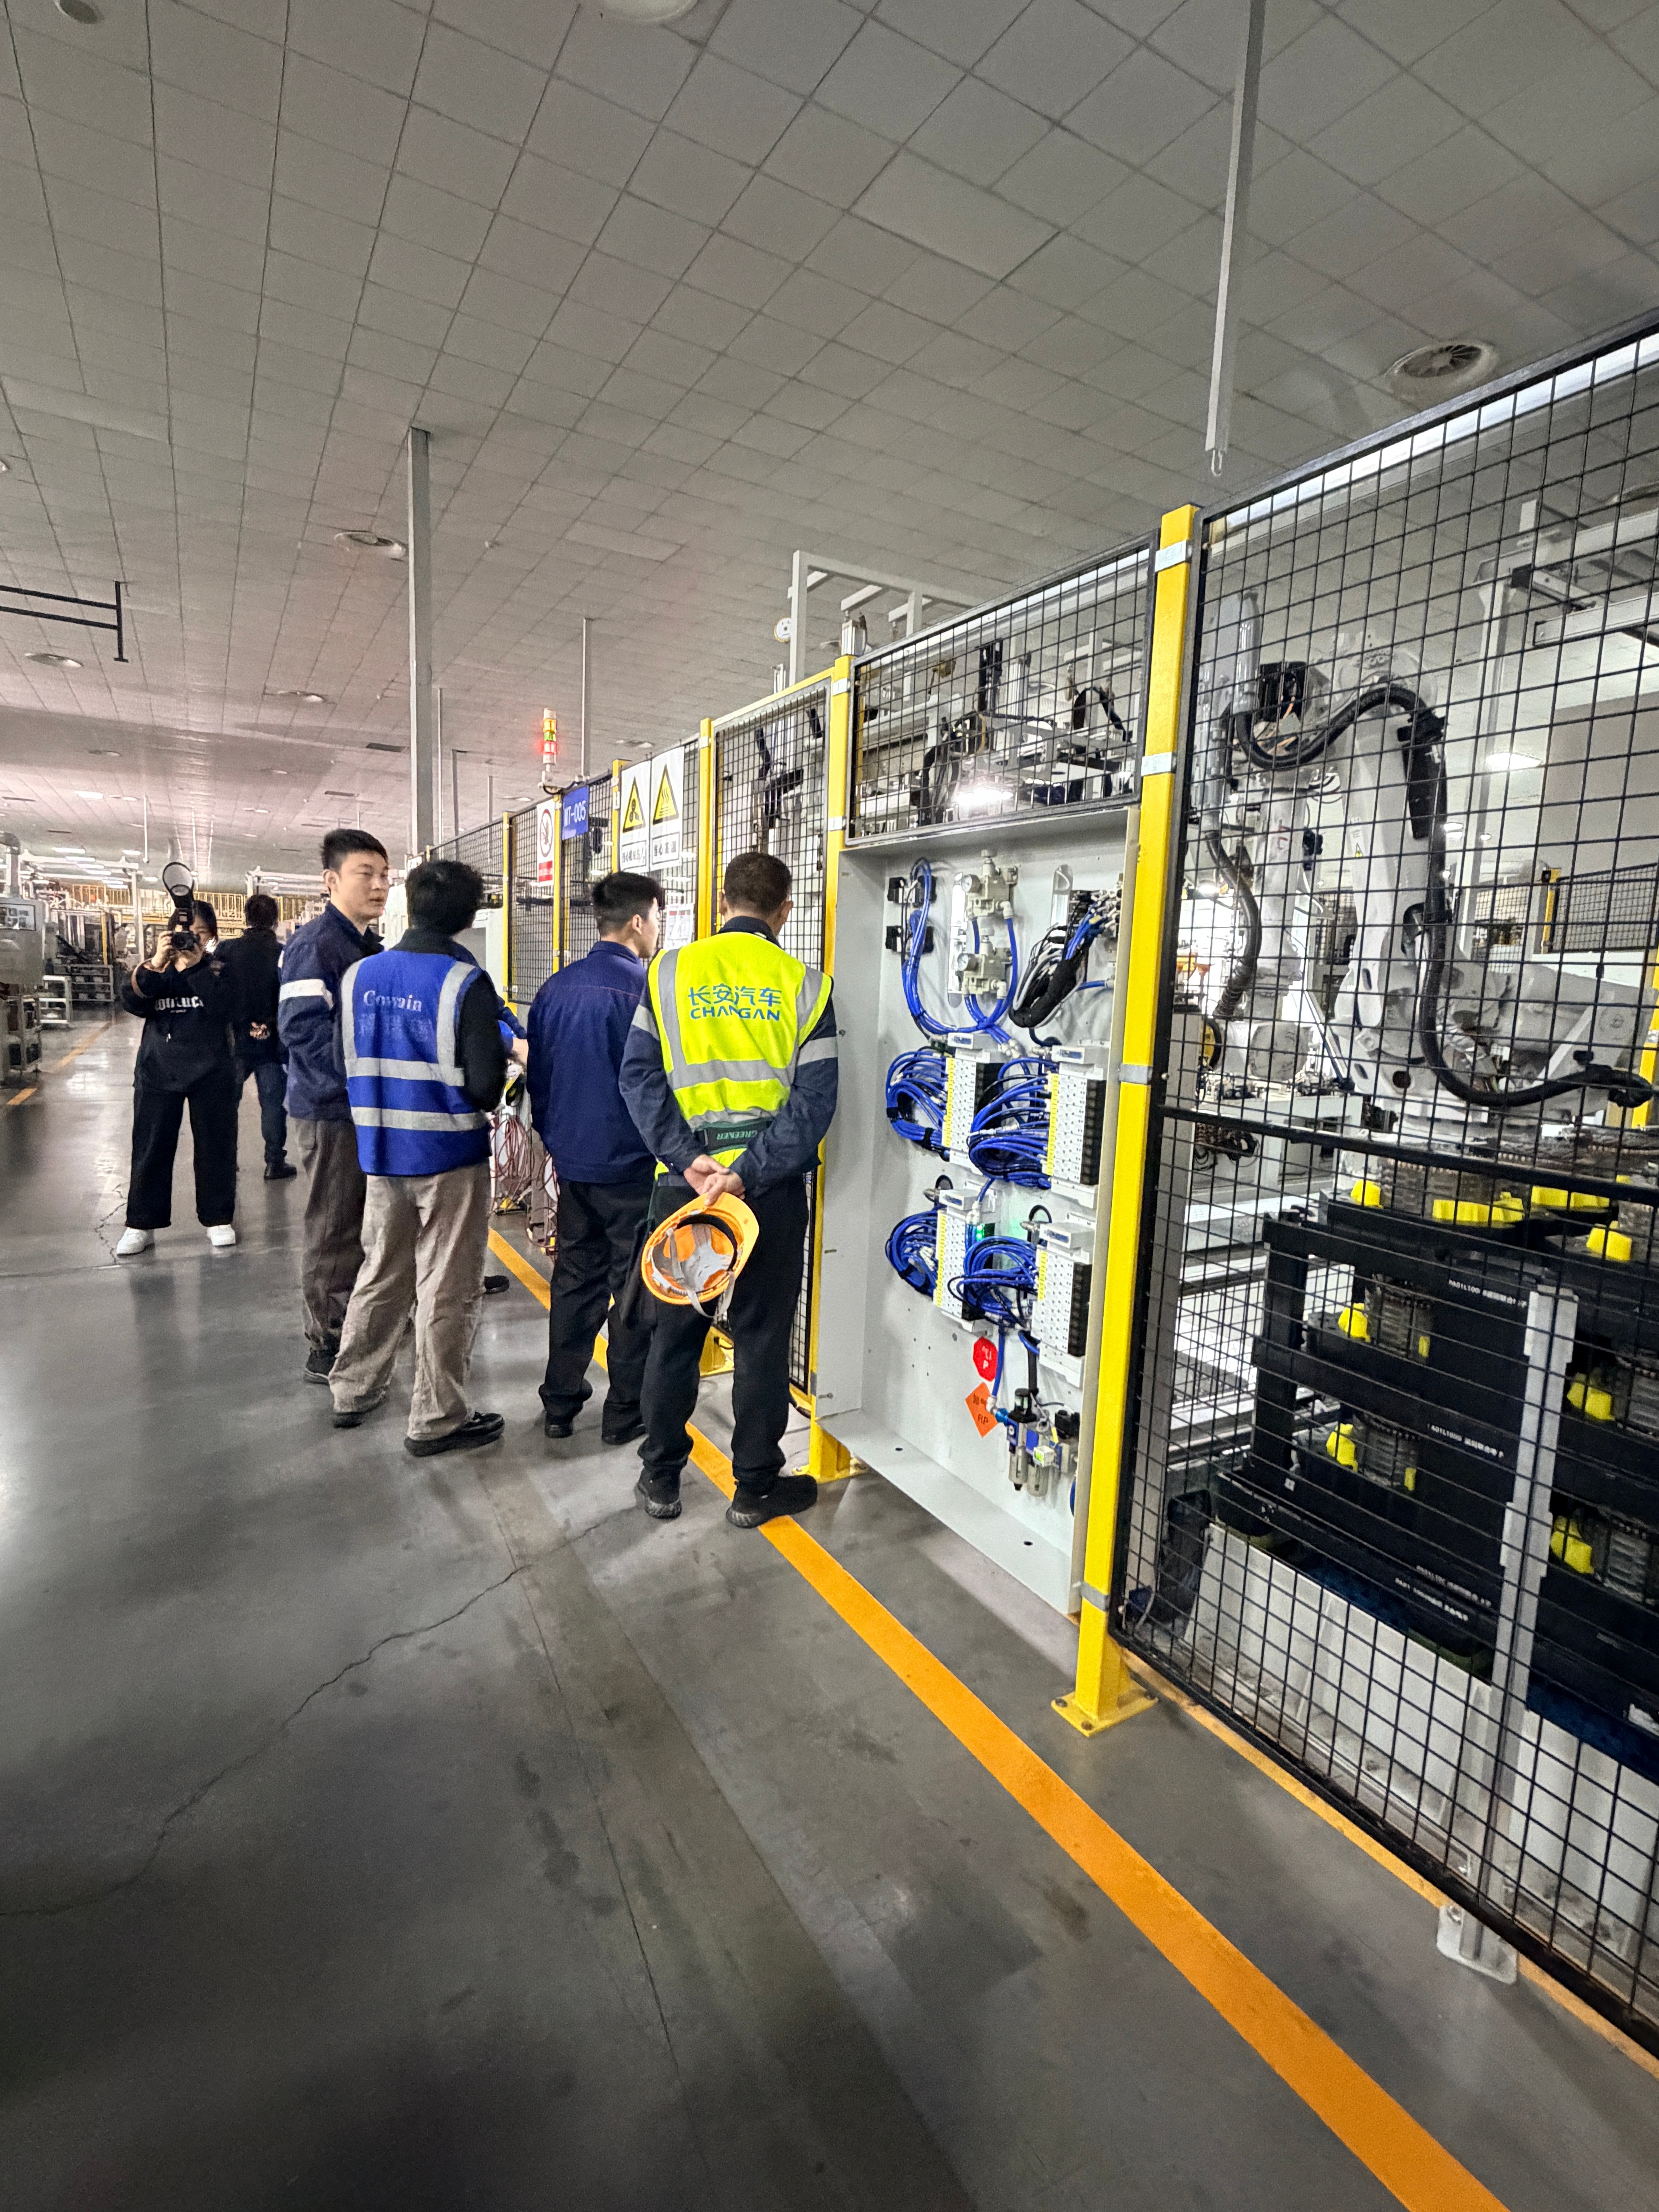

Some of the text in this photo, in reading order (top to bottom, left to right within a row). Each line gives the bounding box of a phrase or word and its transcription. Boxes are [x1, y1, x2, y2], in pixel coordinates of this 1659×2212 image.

[688, 983, 782, 1007] 长安汽车
[690, 1005, 780, 1021] CHANGAN
